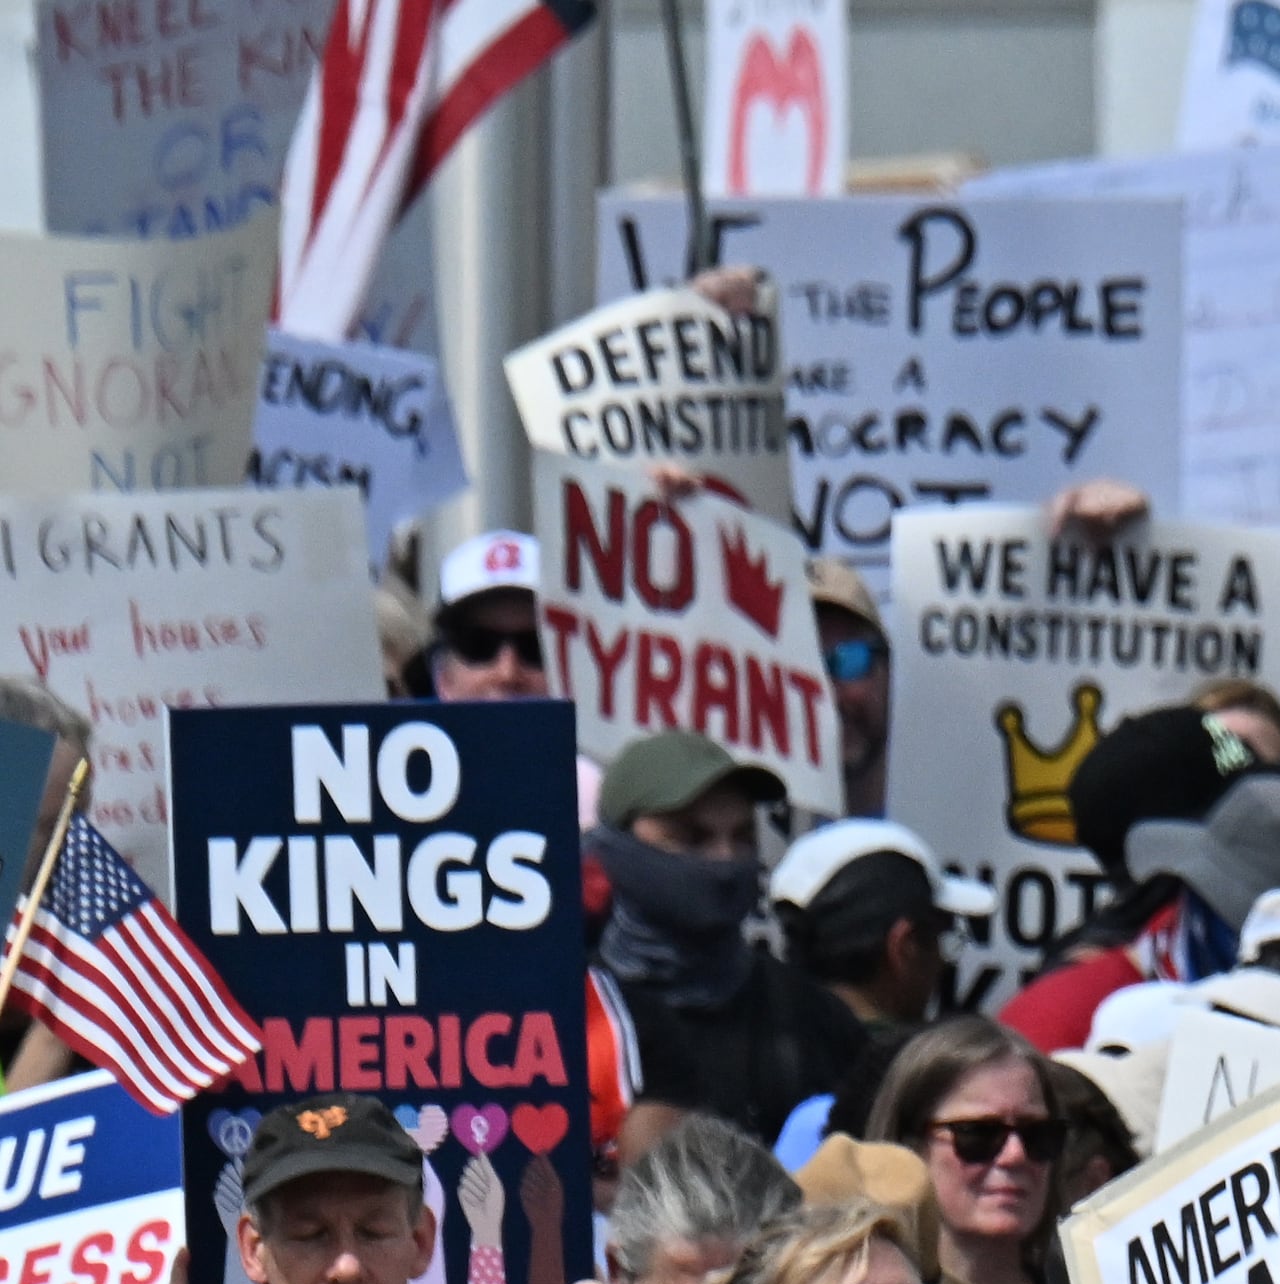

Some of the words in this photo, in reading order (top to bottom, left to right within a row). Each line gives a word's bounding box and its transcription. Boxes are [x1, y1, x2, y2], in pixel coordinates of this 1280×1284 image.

[551, 312, 778, 396] DEFEND
[560, 390, 788, 460] CONSTIT
[563, 478, 696, 613] NO
[934, 538, 1026, 598] WE
[1046, 534, 1196, 608] HAVE
[1220, 554, 1260, 614] A
[917, 605, 1263, 675] CONSTITUTION
[291, 721, 462, 825] NO
[207, 831, 553, 936] KINGS
[344, 942, 418, 1008] IN
[209, 1011, 570, 1094] AMERICA
